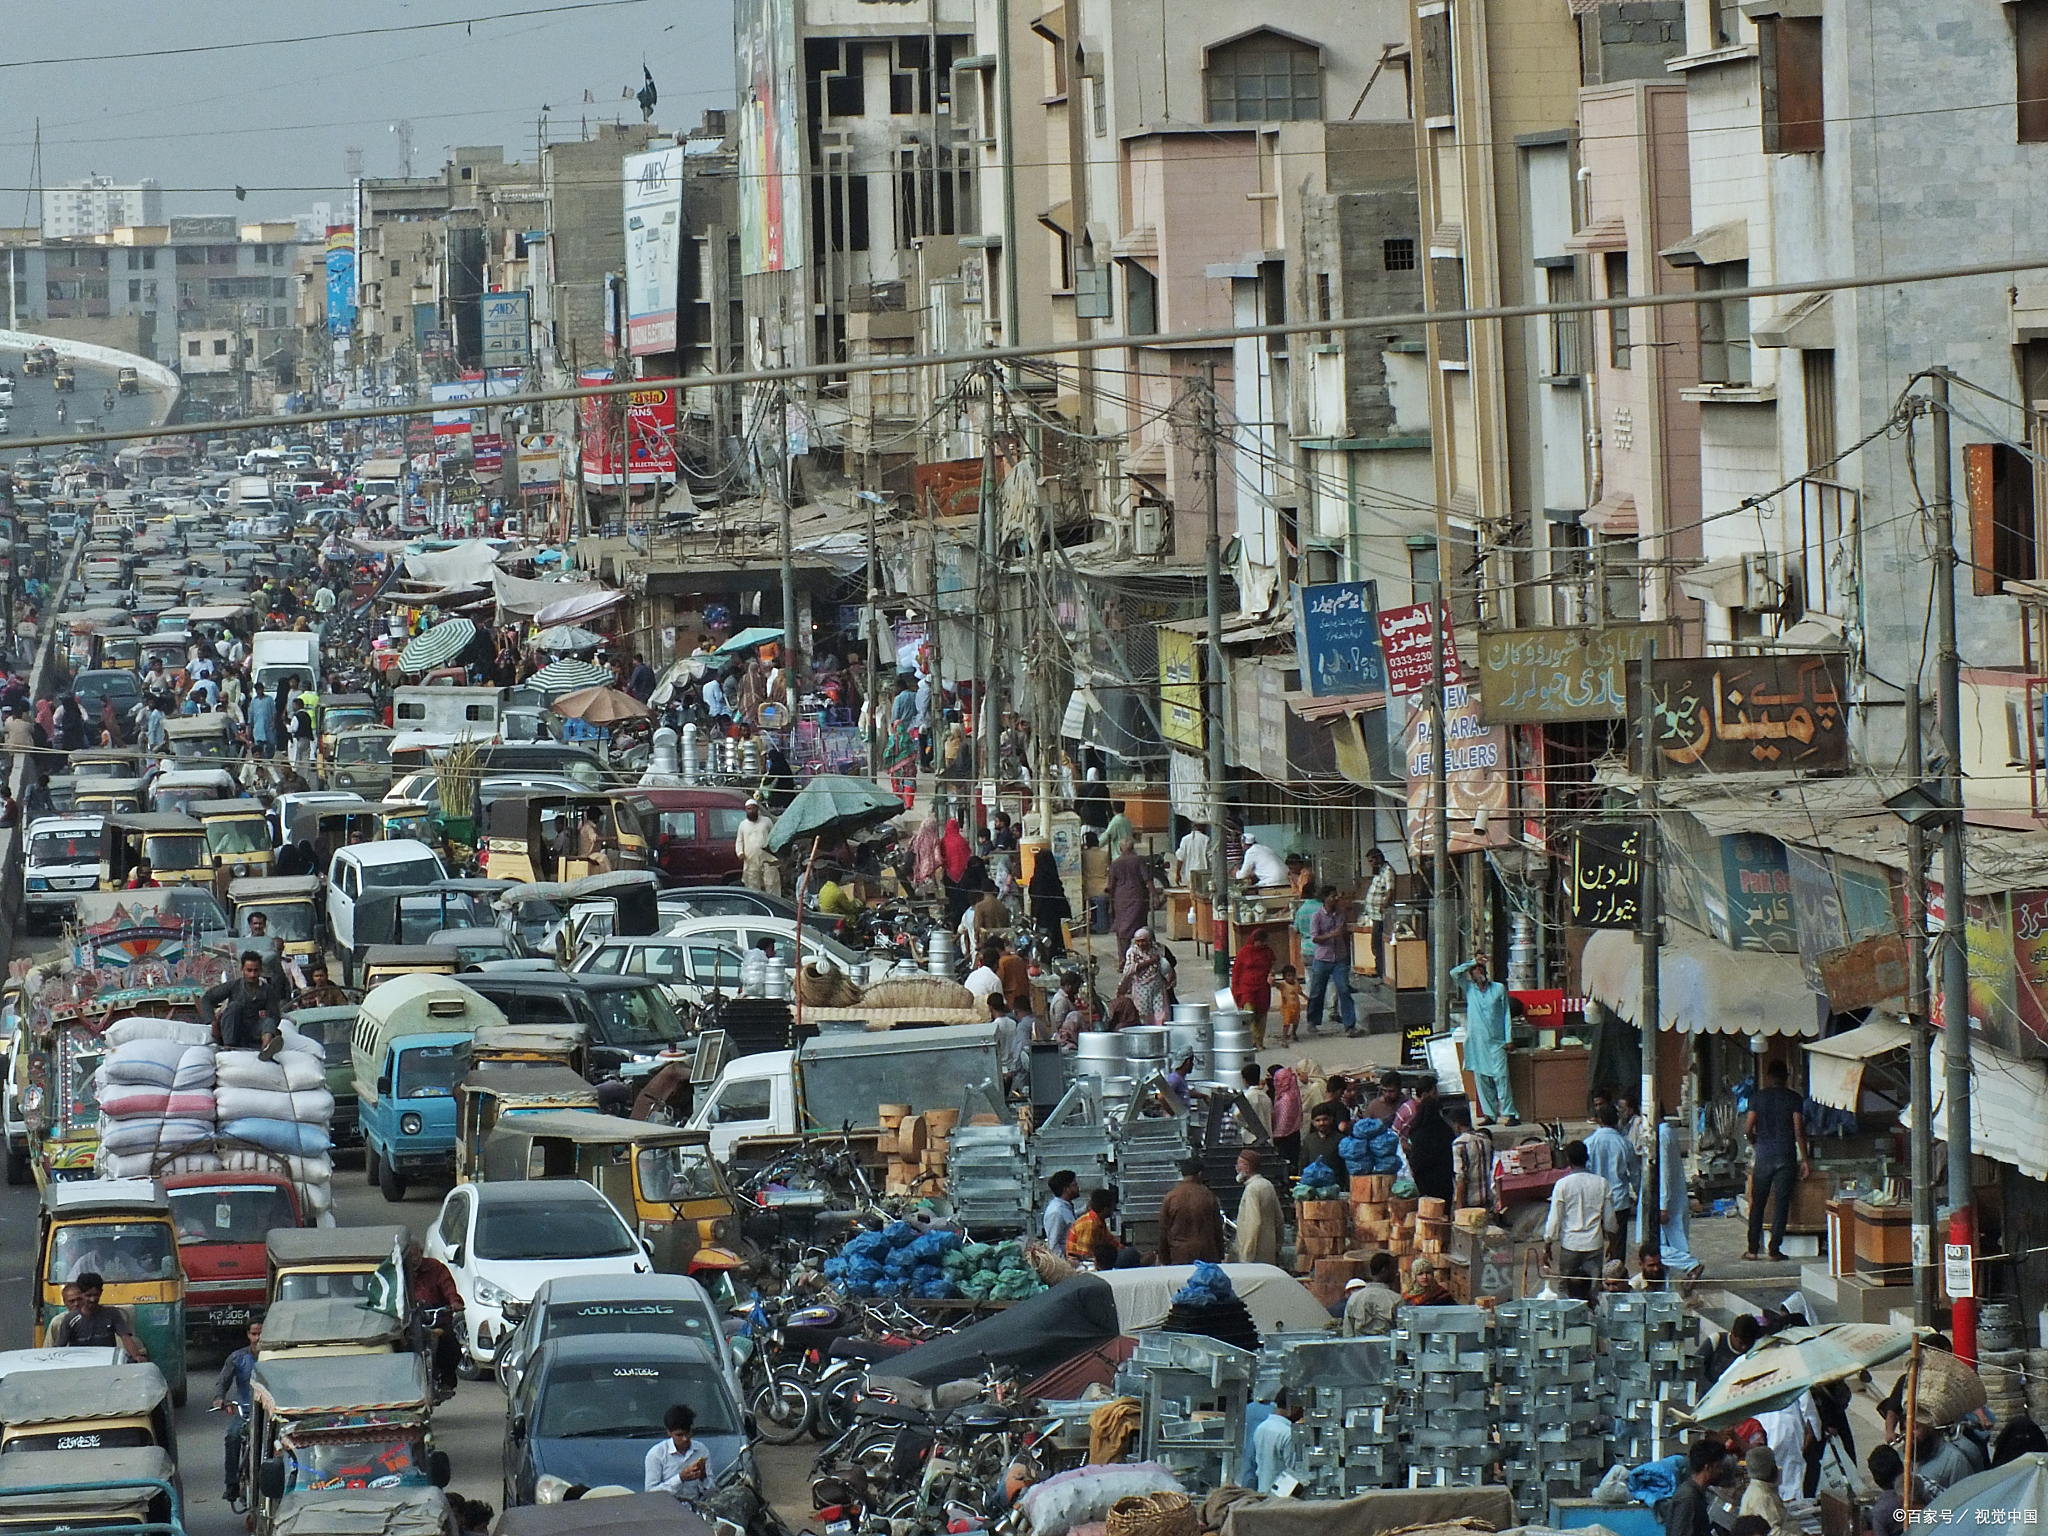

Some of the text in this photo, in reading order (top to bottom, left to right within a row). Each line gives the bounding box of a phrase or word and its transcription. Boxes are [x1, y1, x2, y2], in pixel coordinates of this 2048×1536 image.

[637, 153, 669, 196] ANEX
[488, 299, 520, 318] ANEX
[627, 408, 652, 417] FANS
[1389, 646, 1454, 667] 0333-23043
[1392, 658, 1457, 679] 0315-23043
[1411, 743, 1498, 777] JEELLERS
[1621, 830, 1639, 855] نیو
[1590, 892, 1638, 923] جیولرز
